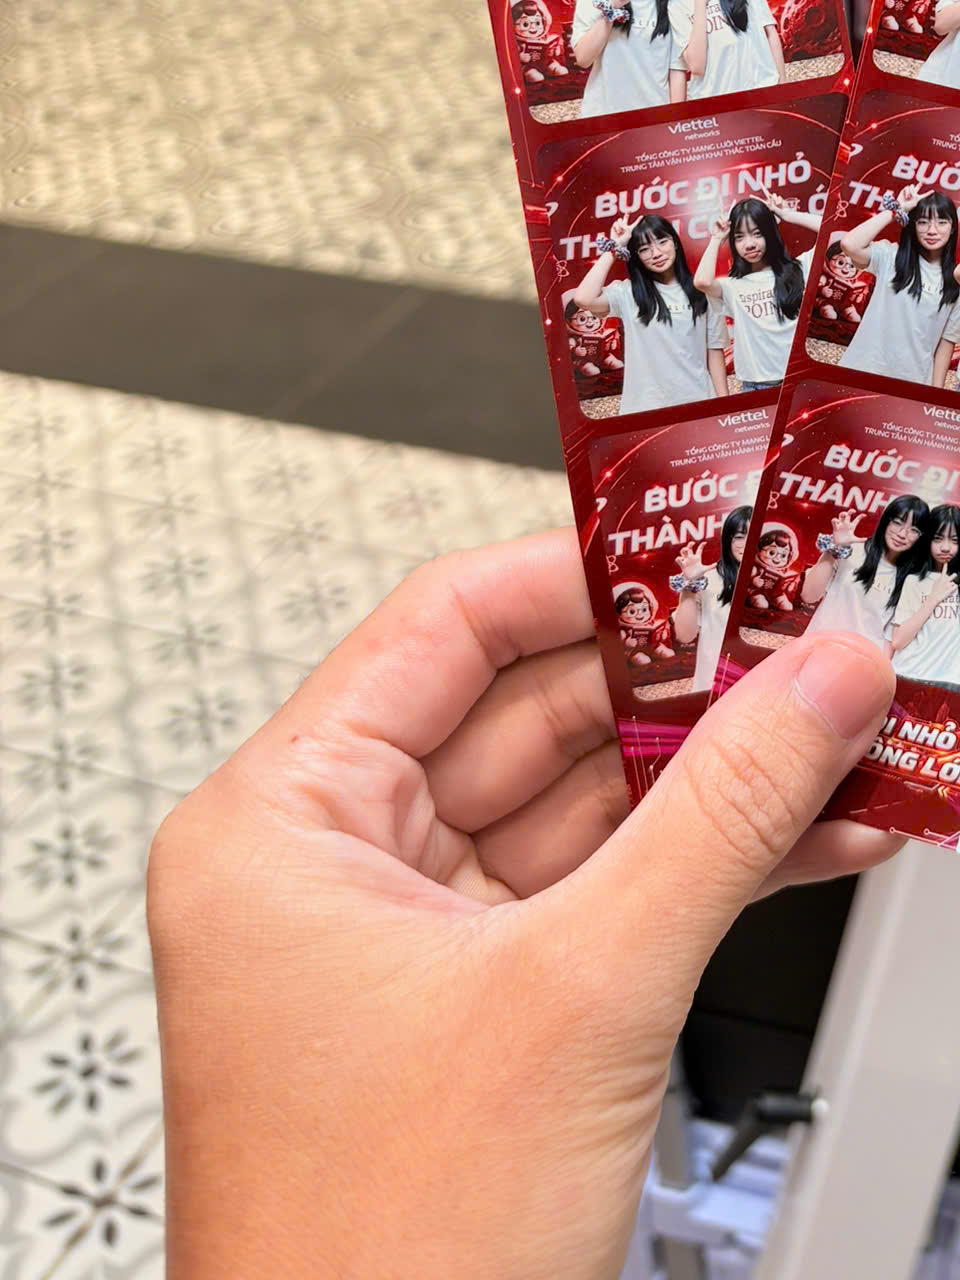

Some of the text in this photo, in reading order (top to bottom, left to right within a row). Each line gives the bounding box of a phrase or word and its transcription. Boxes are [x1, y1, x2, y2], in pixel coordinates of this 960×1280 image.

[668, 118, 719, 134] viettel
[658, 149, 680, 158] CÔNG
[680, 147, 691, 155] TY
[734, 136, 764, 145] VIETTEL
[932, 138, 957, 150] TRUNG
[621, 163, 648, 173] TRUNG
[595, 152, 811, 218] BƯỚC ĐI NHỎ
[718, 410, 768, 427] viettel
[865, 427, 890, 438] TRUNG
[904, 427, 925, 437] CÔNG
[925, 431, 936, 439] TY
[708, 442, 730, 452] CÔNG
[730, 440, 741, 448] TY
[670, 456, 697, 467] TRUNG
[824, 445, 921, 485] BƯỚC
[920, 463, 959, 493] ĐI
[645, 470, 738, 512] BƯỚC
[899, 721, 956, 749] NHỎ
[867, 737, 919, 770] ÔNG
